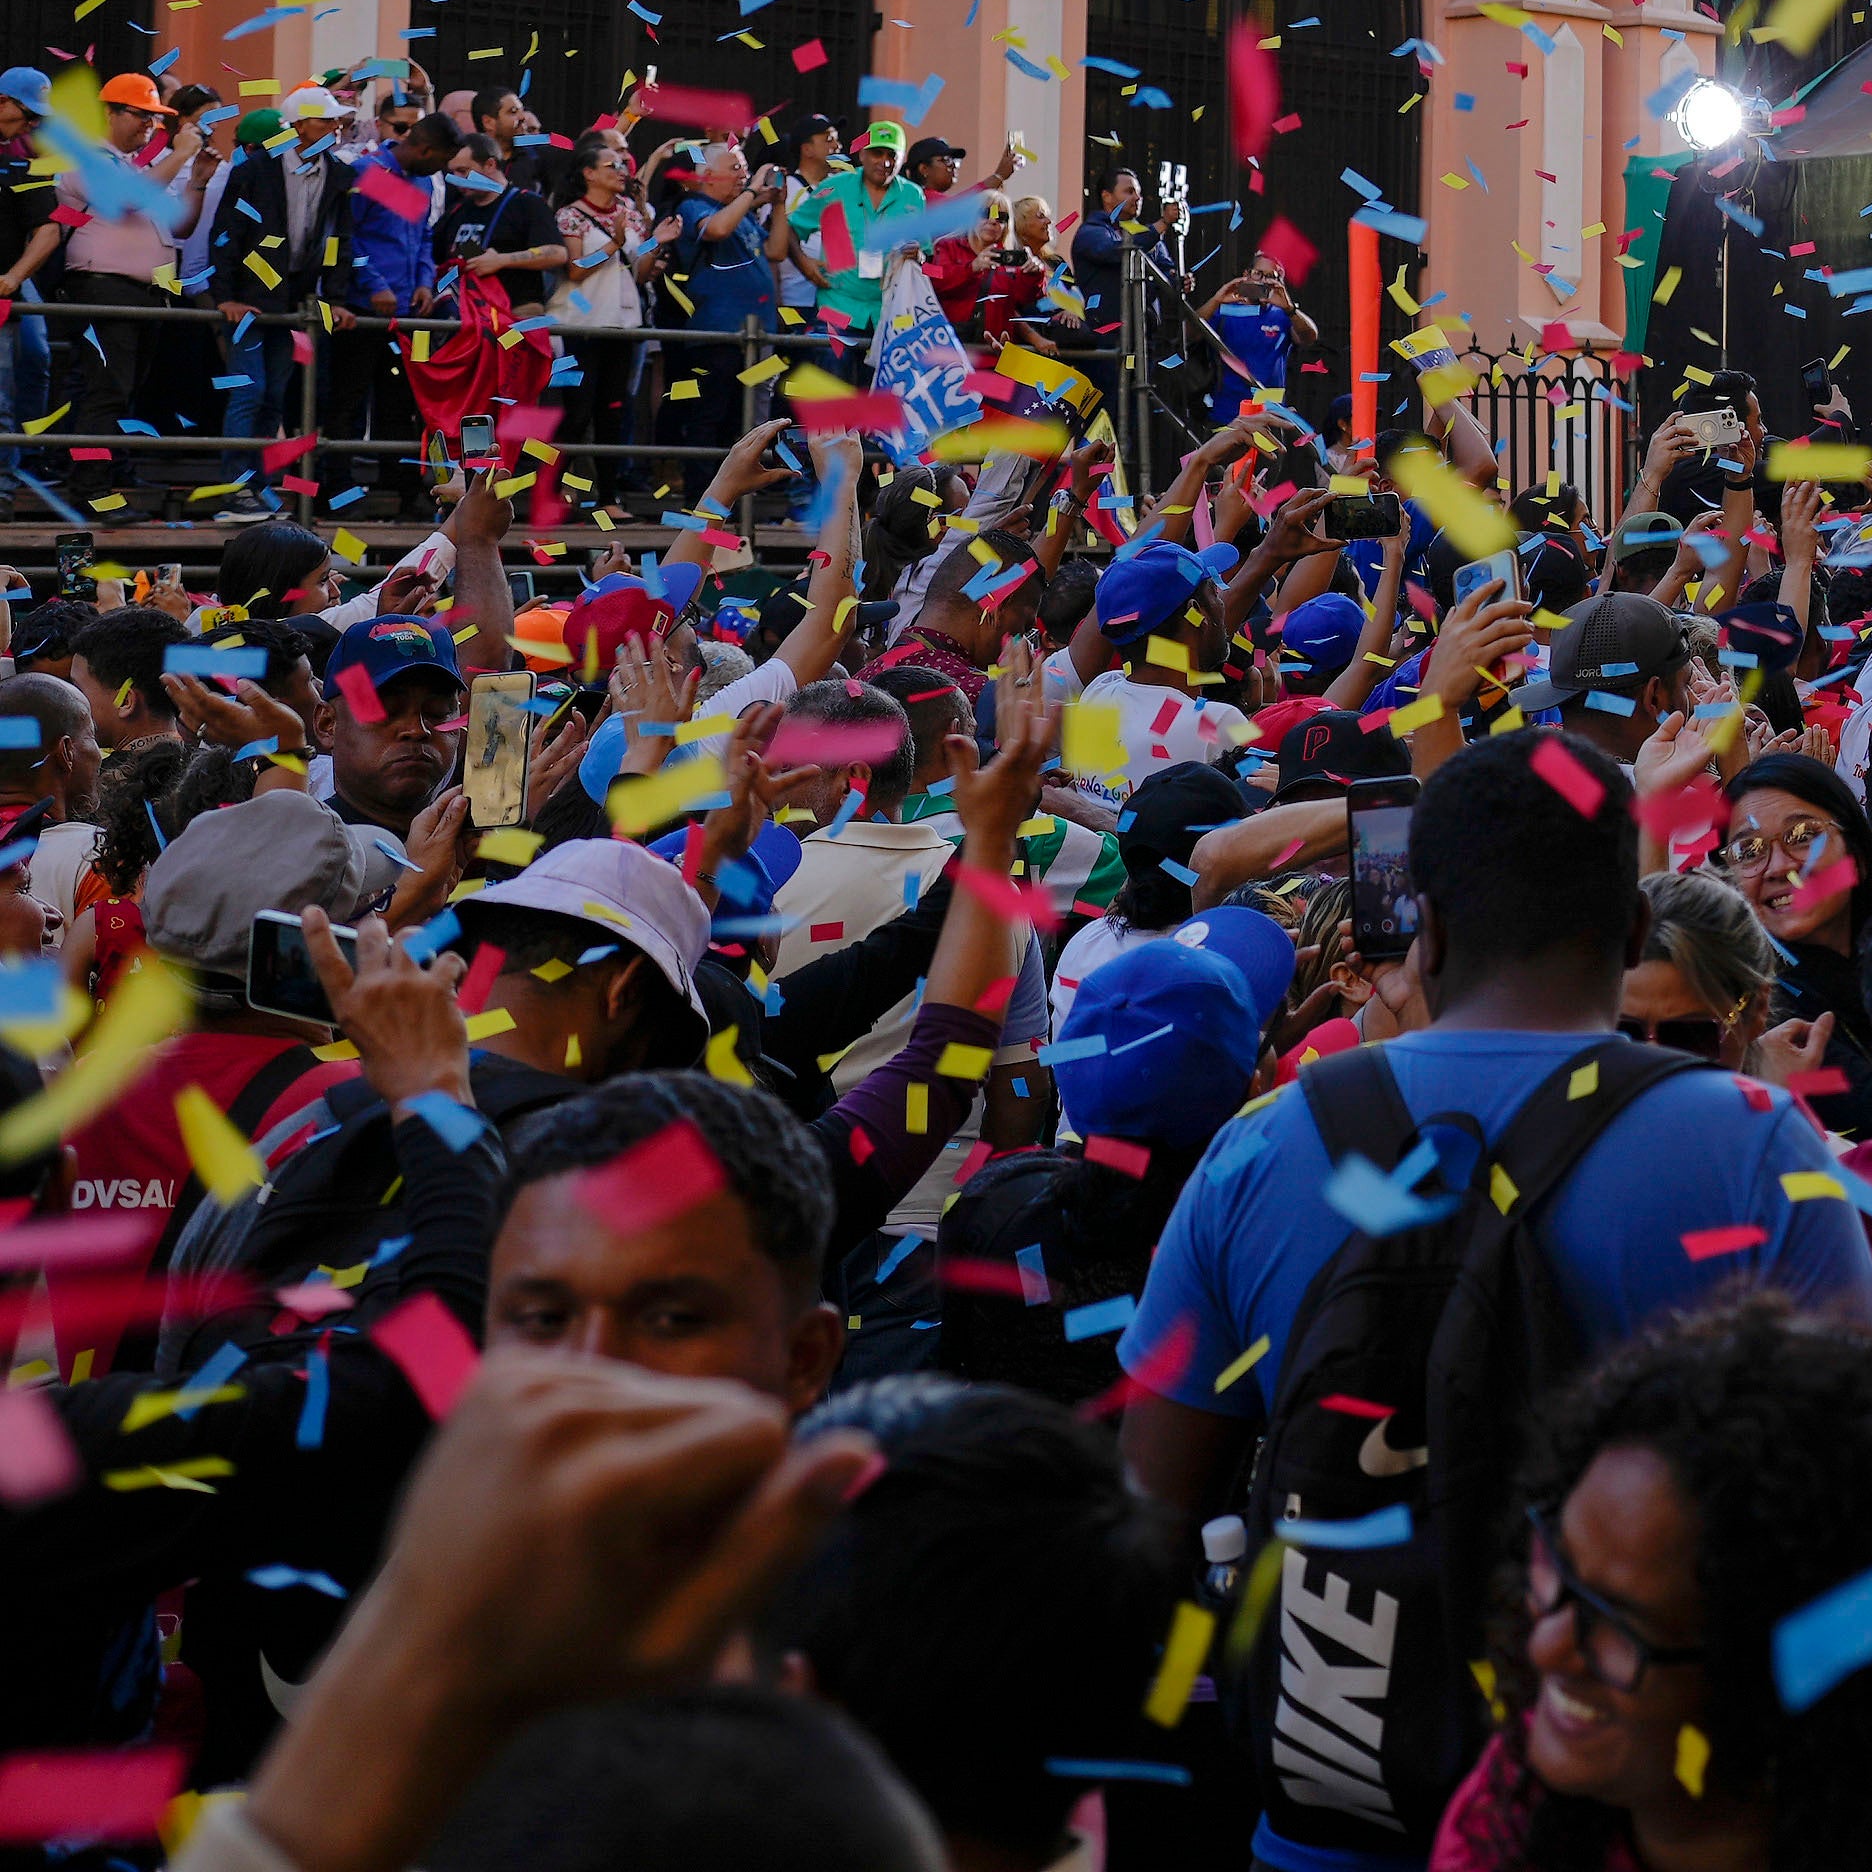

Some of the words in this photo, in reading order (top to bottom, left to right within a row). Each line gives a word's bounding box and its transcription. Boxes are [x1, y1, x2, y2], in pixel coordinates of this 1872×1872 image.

[1575, 668, 1603, 679] JORD
[1303, 725, 1331, 761] P
[72, 1179, 167, 1209] DVSA
[1272, 1546, 1408, 1834] NIKE
